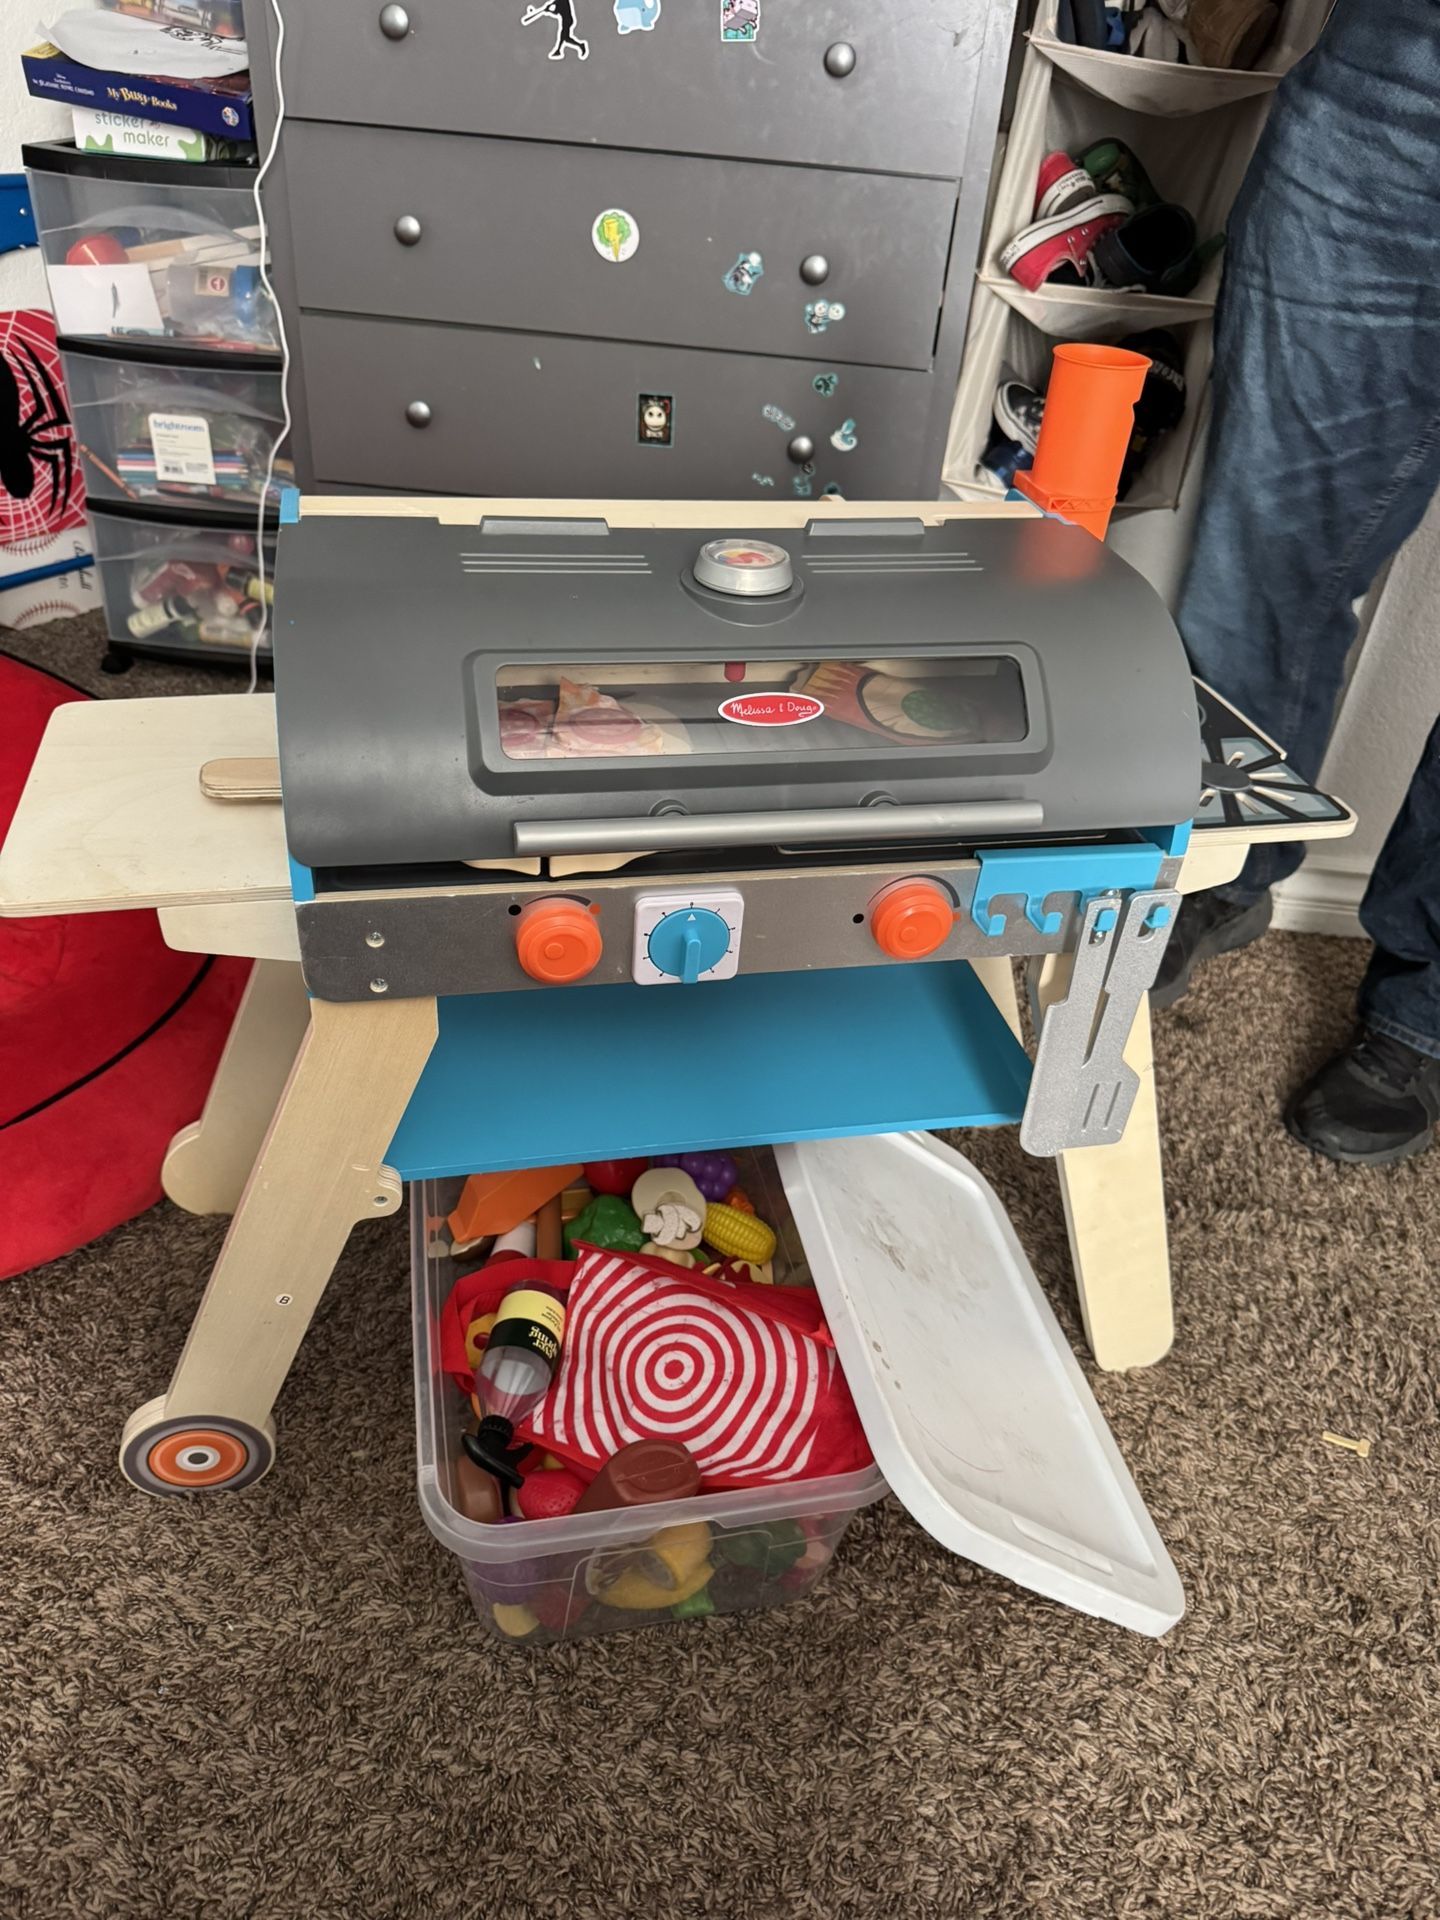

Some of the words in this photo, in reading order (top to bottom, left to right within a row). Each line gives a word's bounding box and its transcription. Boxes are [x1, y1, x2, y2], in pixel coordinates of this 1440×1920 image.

[106, 87, 120, 100] My
[120, 87, 149, 106] Busy
[152, 96, 178, 110] Books
[95, 112, 146, 129] sticker
[123, 131, 170, 147] maker
[153, 419, 205, 433] brightroom
[730, 702, 775, 717] Melissa
[787, 702, 813, 717] Doug
[279, 1296, 290, 1304] B
